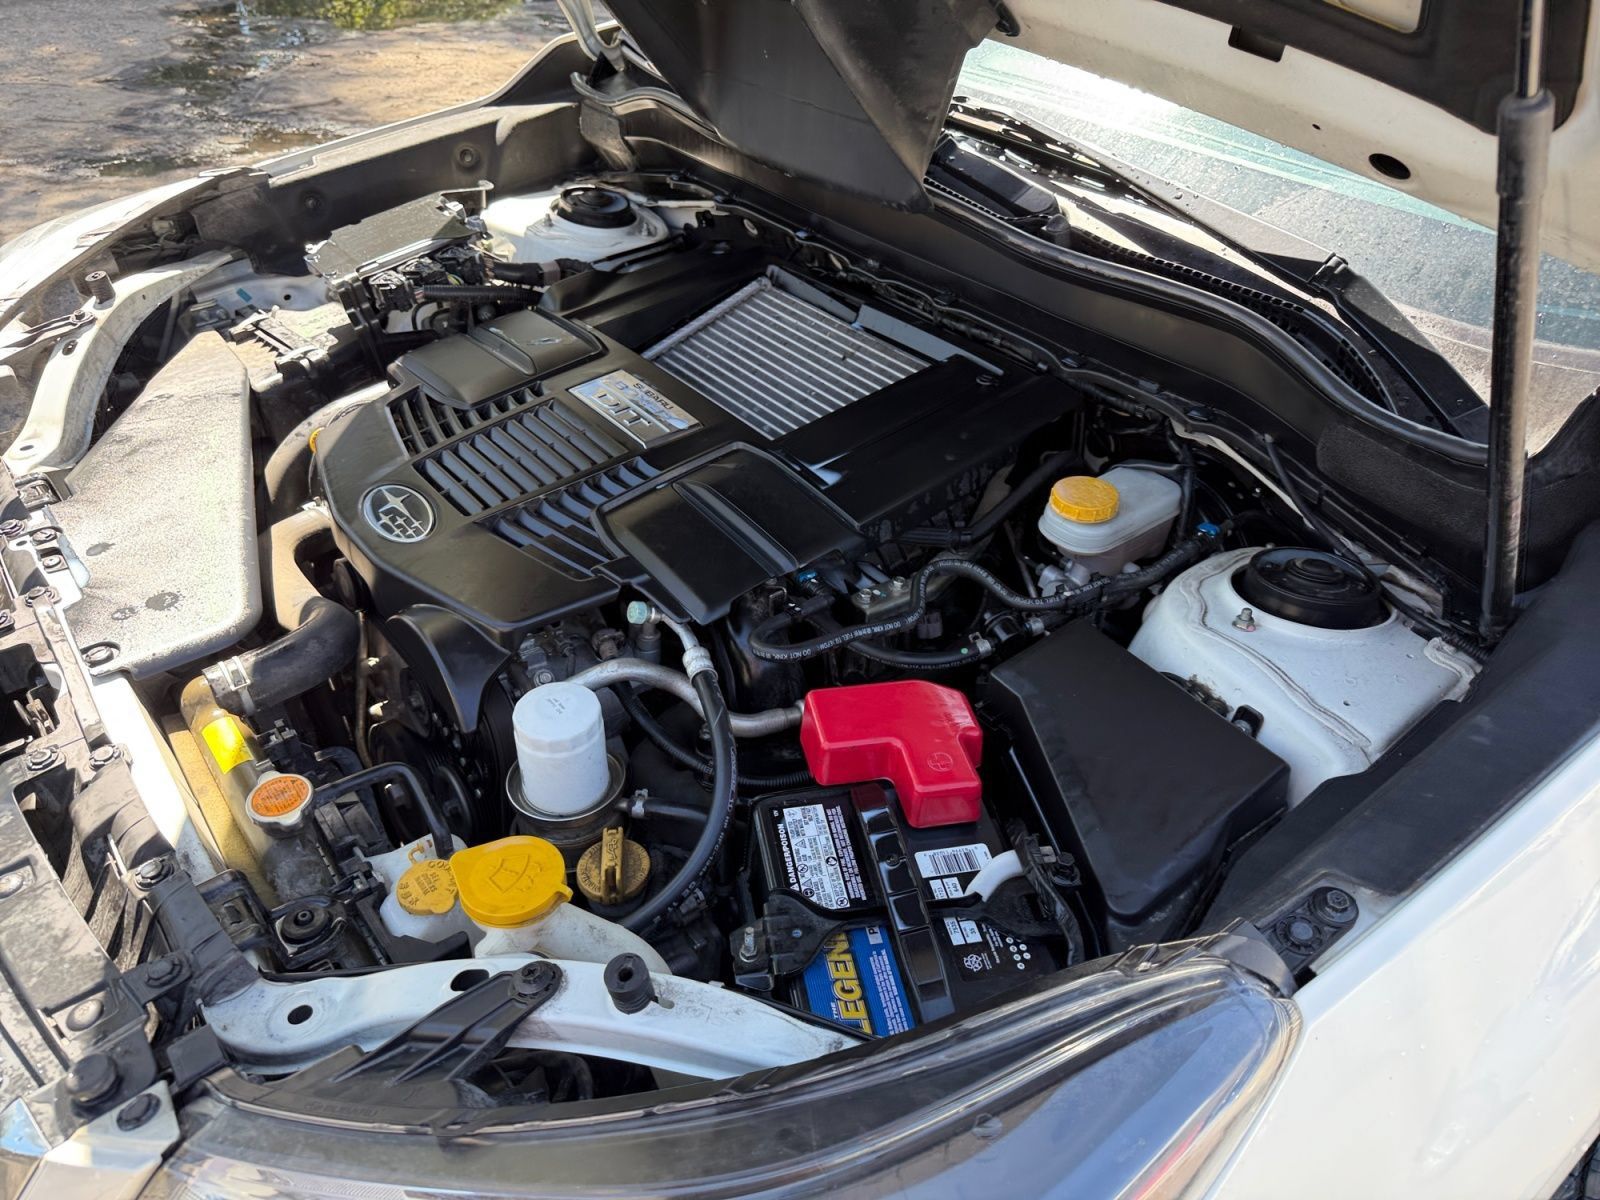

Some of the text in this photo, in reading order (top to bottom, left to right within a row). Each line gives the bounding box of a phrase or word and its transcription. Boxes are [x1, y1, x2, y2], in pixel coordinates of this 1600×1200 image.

[591, 390, 652, 427] DIT
[633, 383, 673, 410] SUBARU
[777, 823, 797, 883] DANGER/POISON
